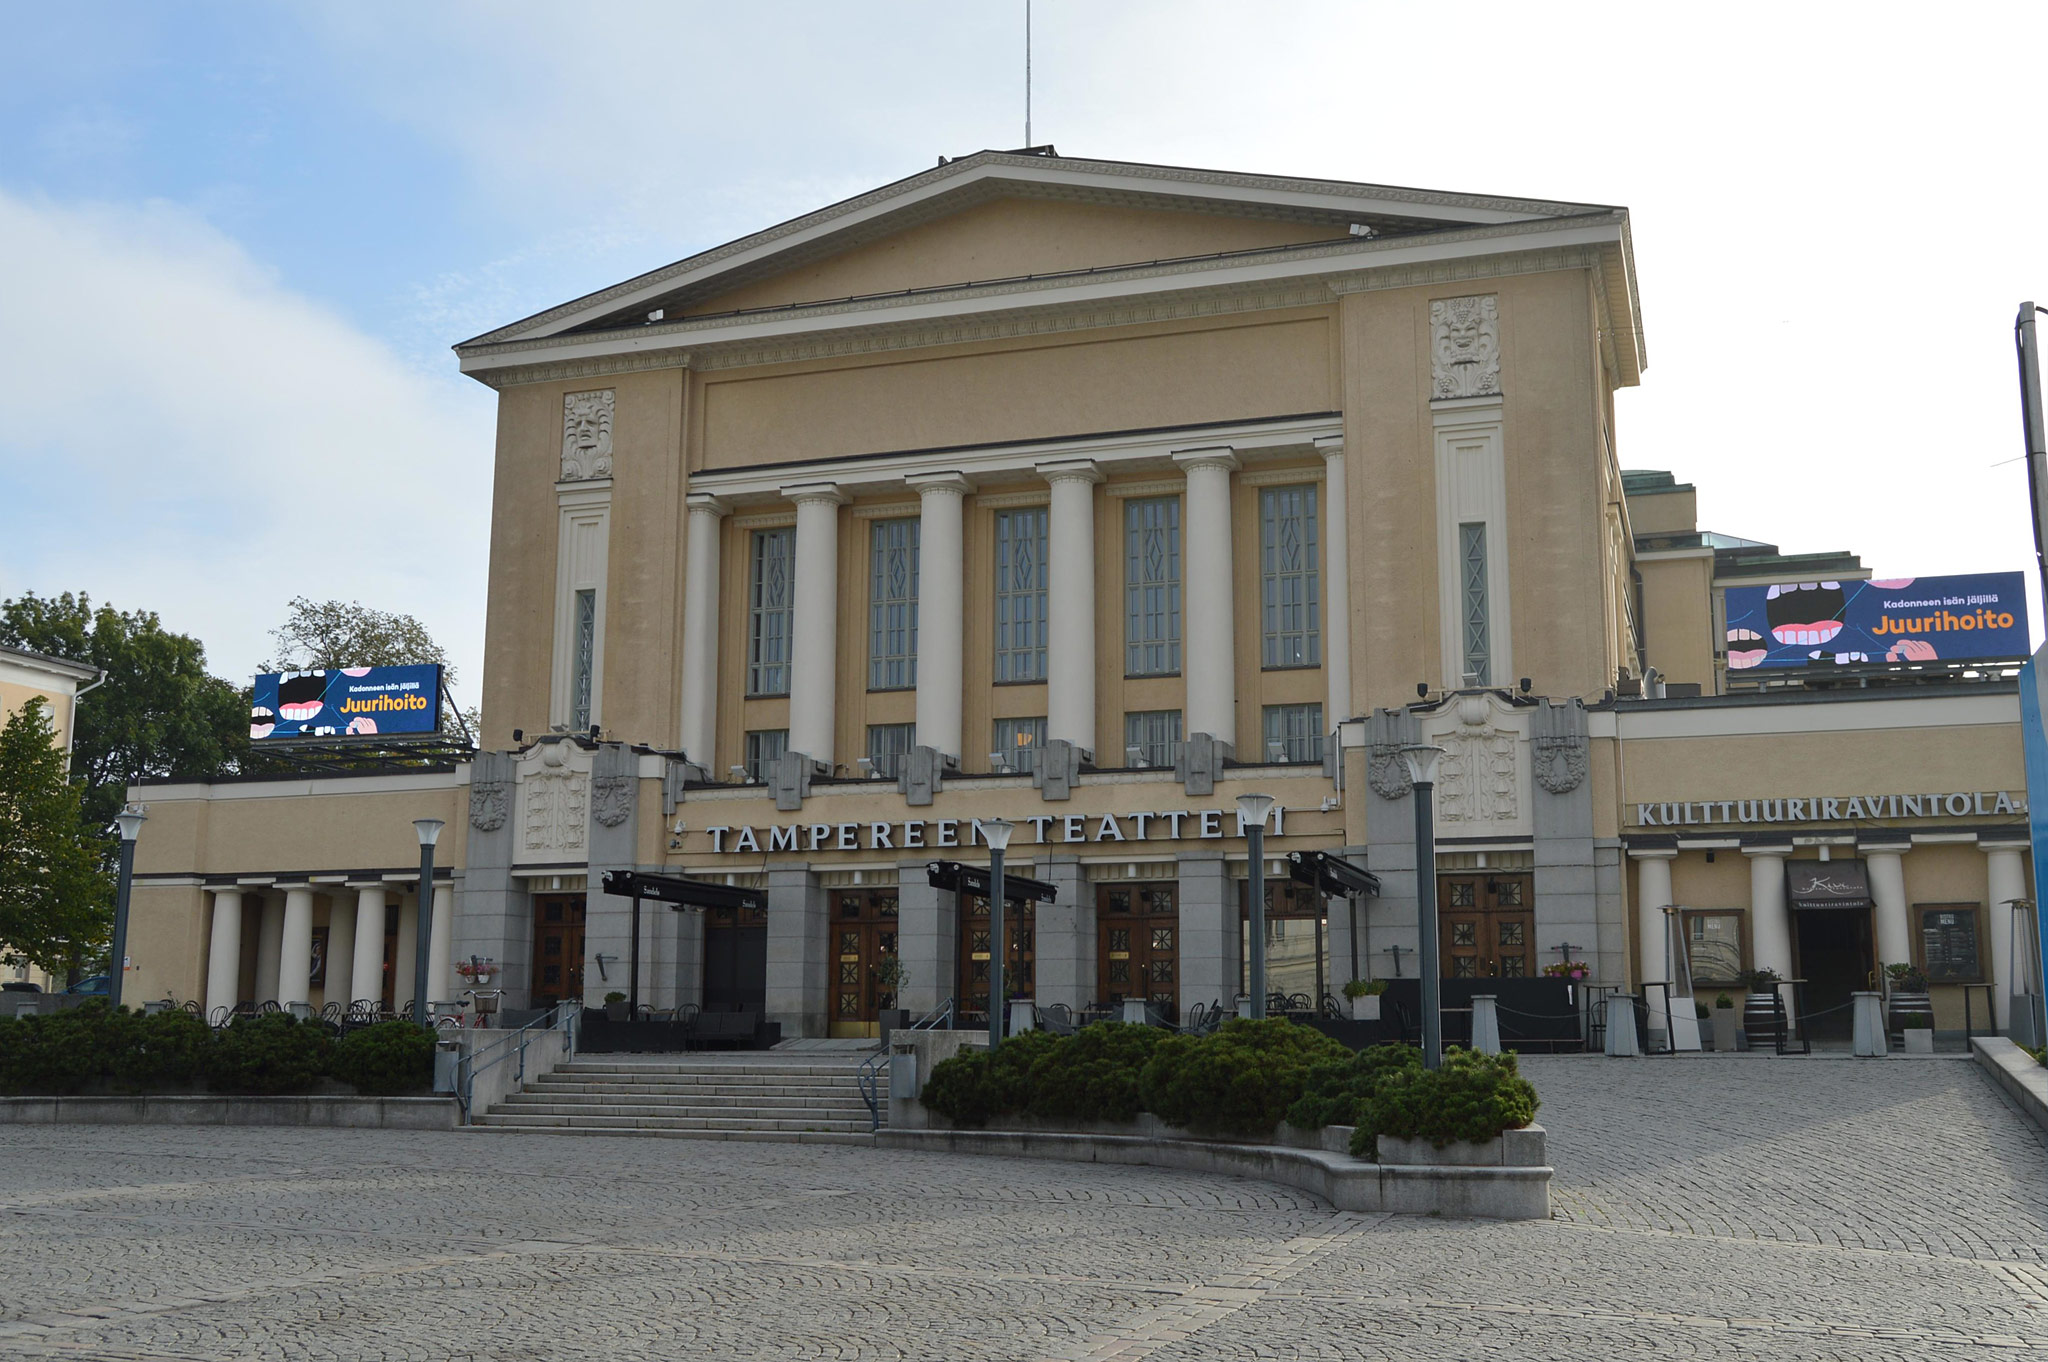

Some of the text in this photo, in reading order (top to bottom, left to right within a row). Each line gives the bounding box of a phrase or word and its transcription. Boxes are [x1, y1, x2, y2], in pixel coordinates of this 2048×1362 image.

[1883, 594, 1999, 608] Kadonneen isän jäljillä
[1872, 608, 2014, 635] Juurihoito
[349, 684, 384, 692] Kadonneen
[385, 682, 399, 691] isän
[340, 693, 427, 713] Juurihoito
[1637, 791, 2015, 826] KULTTUURIRAVINTOLA
[706, 817, 998, 852] TAMPEREEN
